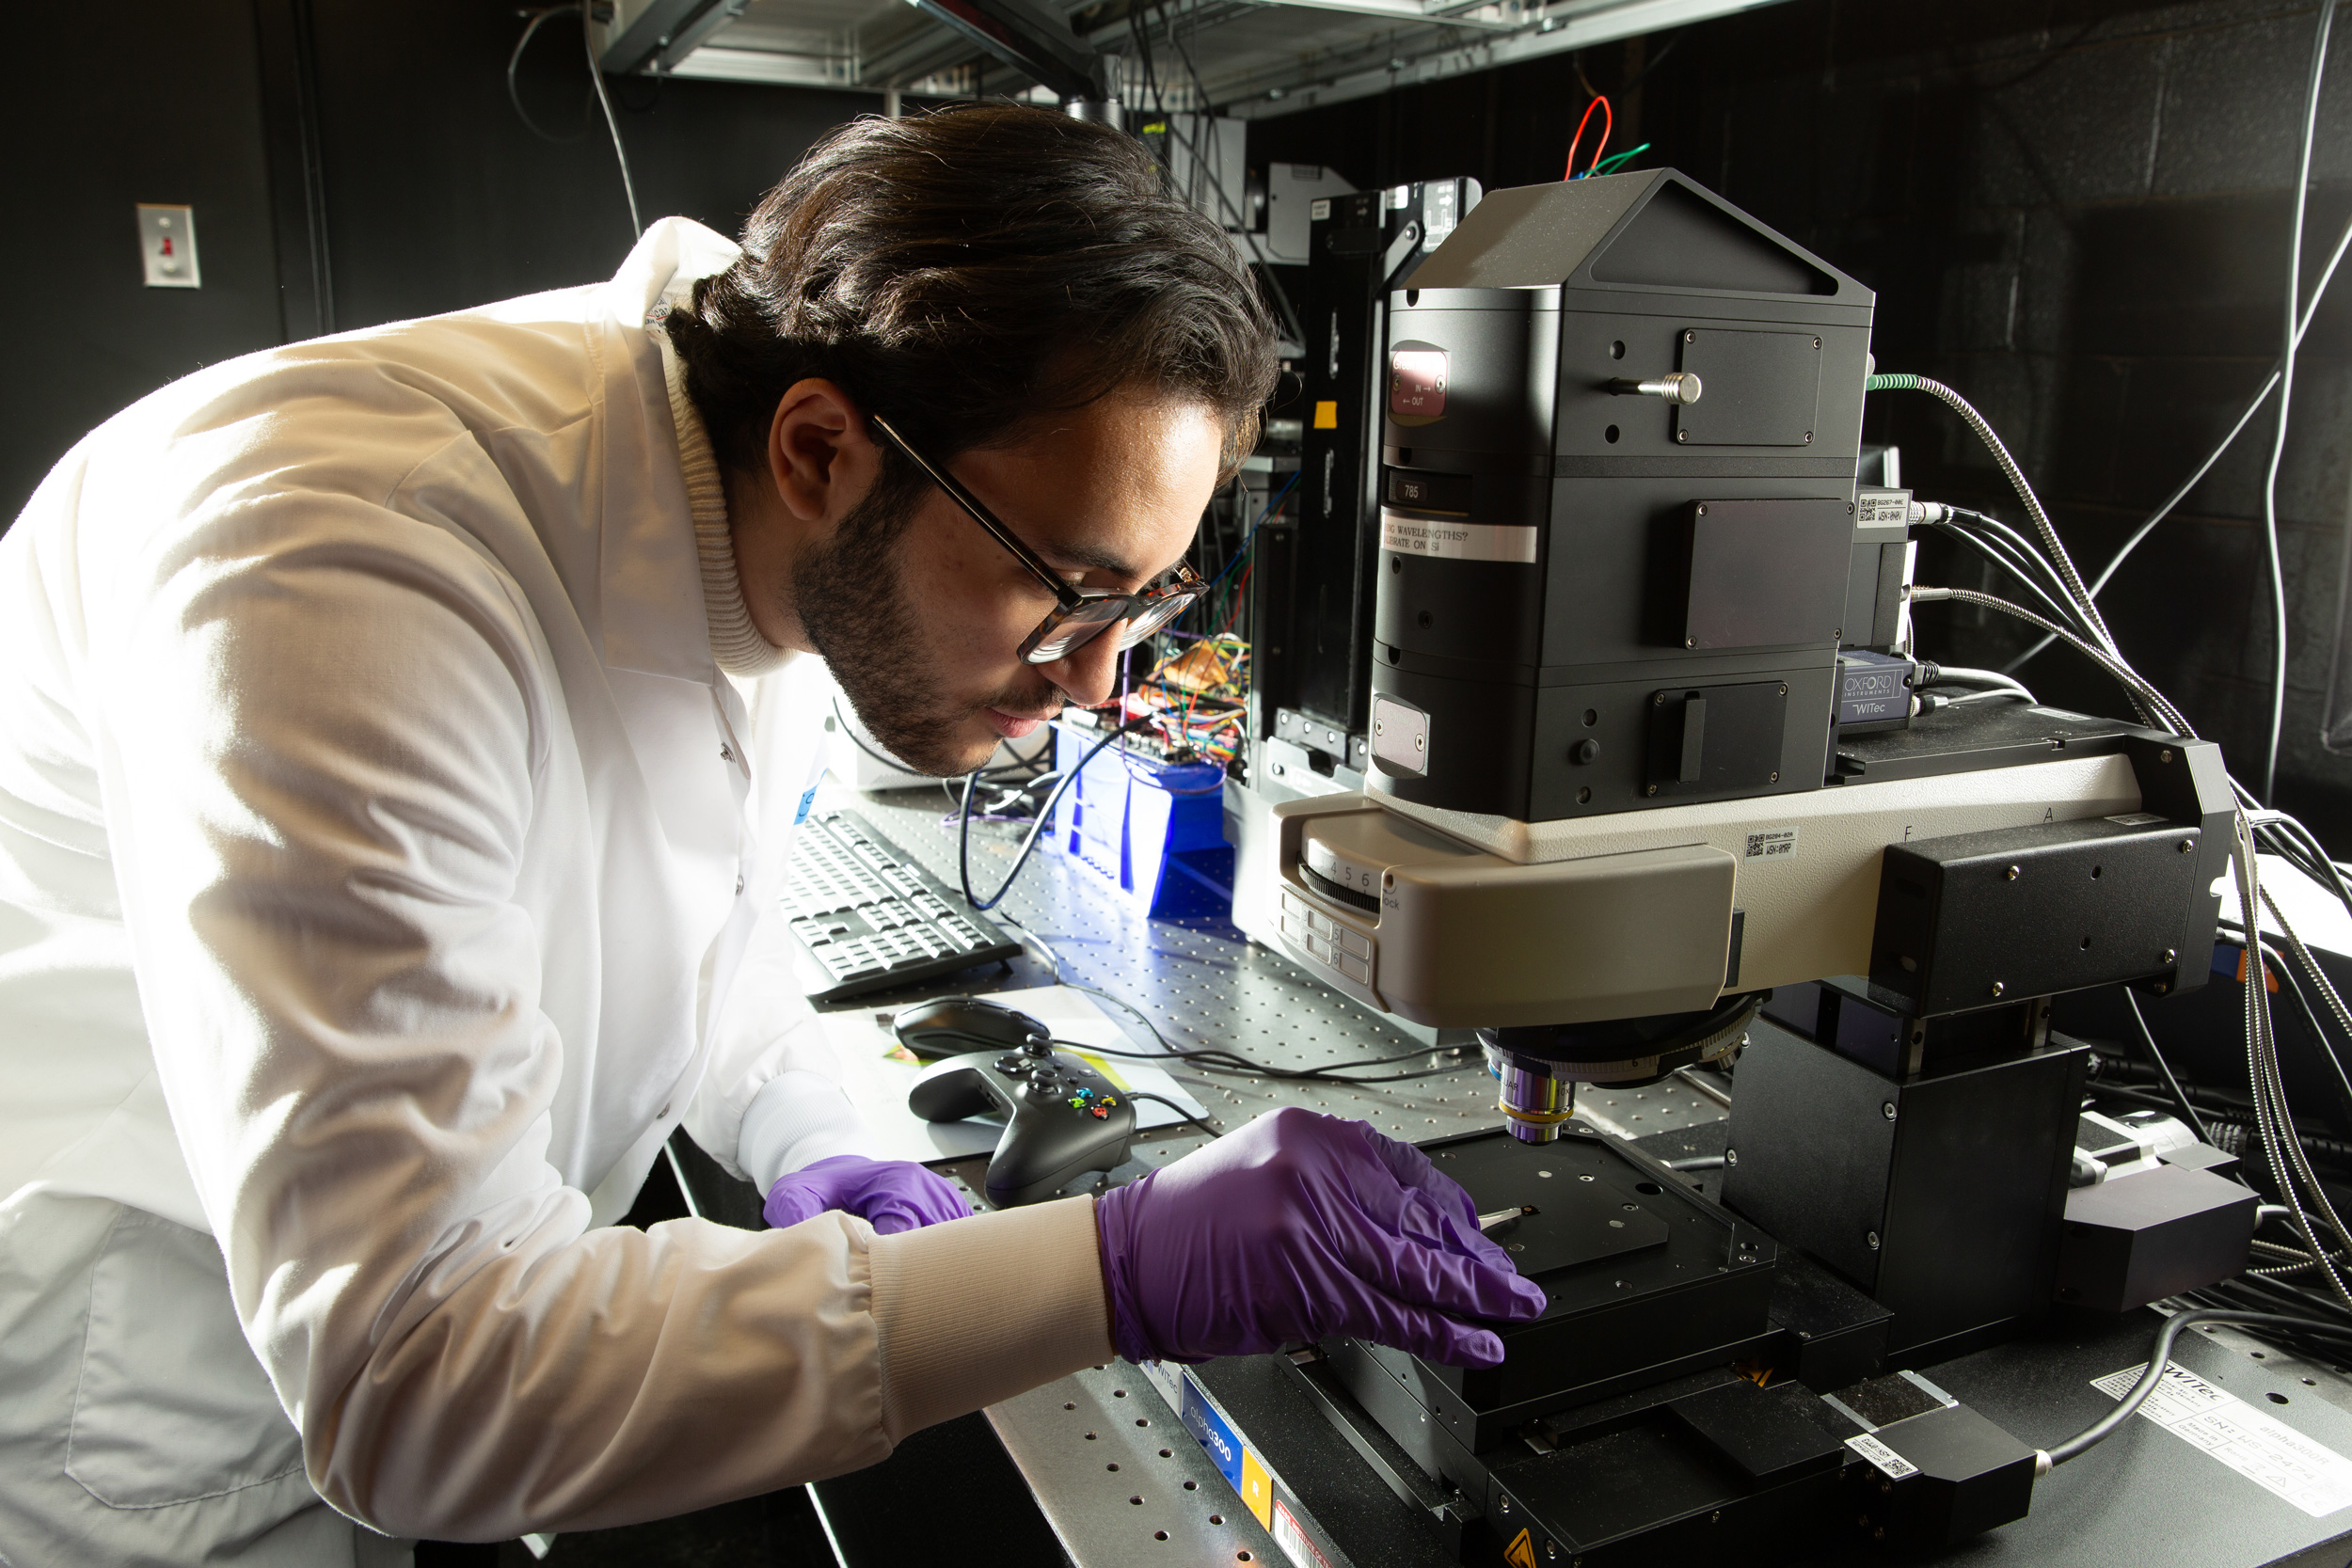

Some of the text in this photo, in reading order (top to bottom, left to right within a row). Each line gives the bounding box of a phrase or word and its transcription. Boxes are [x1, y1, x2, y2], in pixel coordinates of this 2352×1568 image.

[1415, 384, 1422, 393] IN
[1411, 397, 1423, 406] OUT
[1405, 484, 1419, 499] 785
[1397, 525, 1469, 542] WAVELENGTHS?
[1413, 540, 1426, 550] ON
[1431, 542, 1439, 552] Si
[1844, 675, 1892, 692] OXFORD
[1844, 689, 1890, 697] INSTRUMENTS
[1852, 703, 1885, 716] WITec
[2042, 807, 2054, 823] A
[1904, 825, 1913, 843] F
[1345, 866, 1352, 880] 5
[1361, 873, 1370, 887] 6
[1334, 928, 1339, 941] 5
[1333, 953, 1339, 965] 6
[1632, 1058, 1639, 1068] 6
[1158, 1364, 1178, 1394] WITec
[2165, 1363, 2225, 1401] WITec
[1190, 1406, 1232, 1462] alpha300
[2179, 1424, 2215, 1447] Germany
[2186, 1421, 2209, 1436] Made
[2203, 1415, 2315, 1481] SN: WS-2474
[2259, 1425, 2330, 1465] alpha300R
[1252, 1480, 1260, 1497] R
[1292, 1520, 1315, 1553] INSTITUTE
